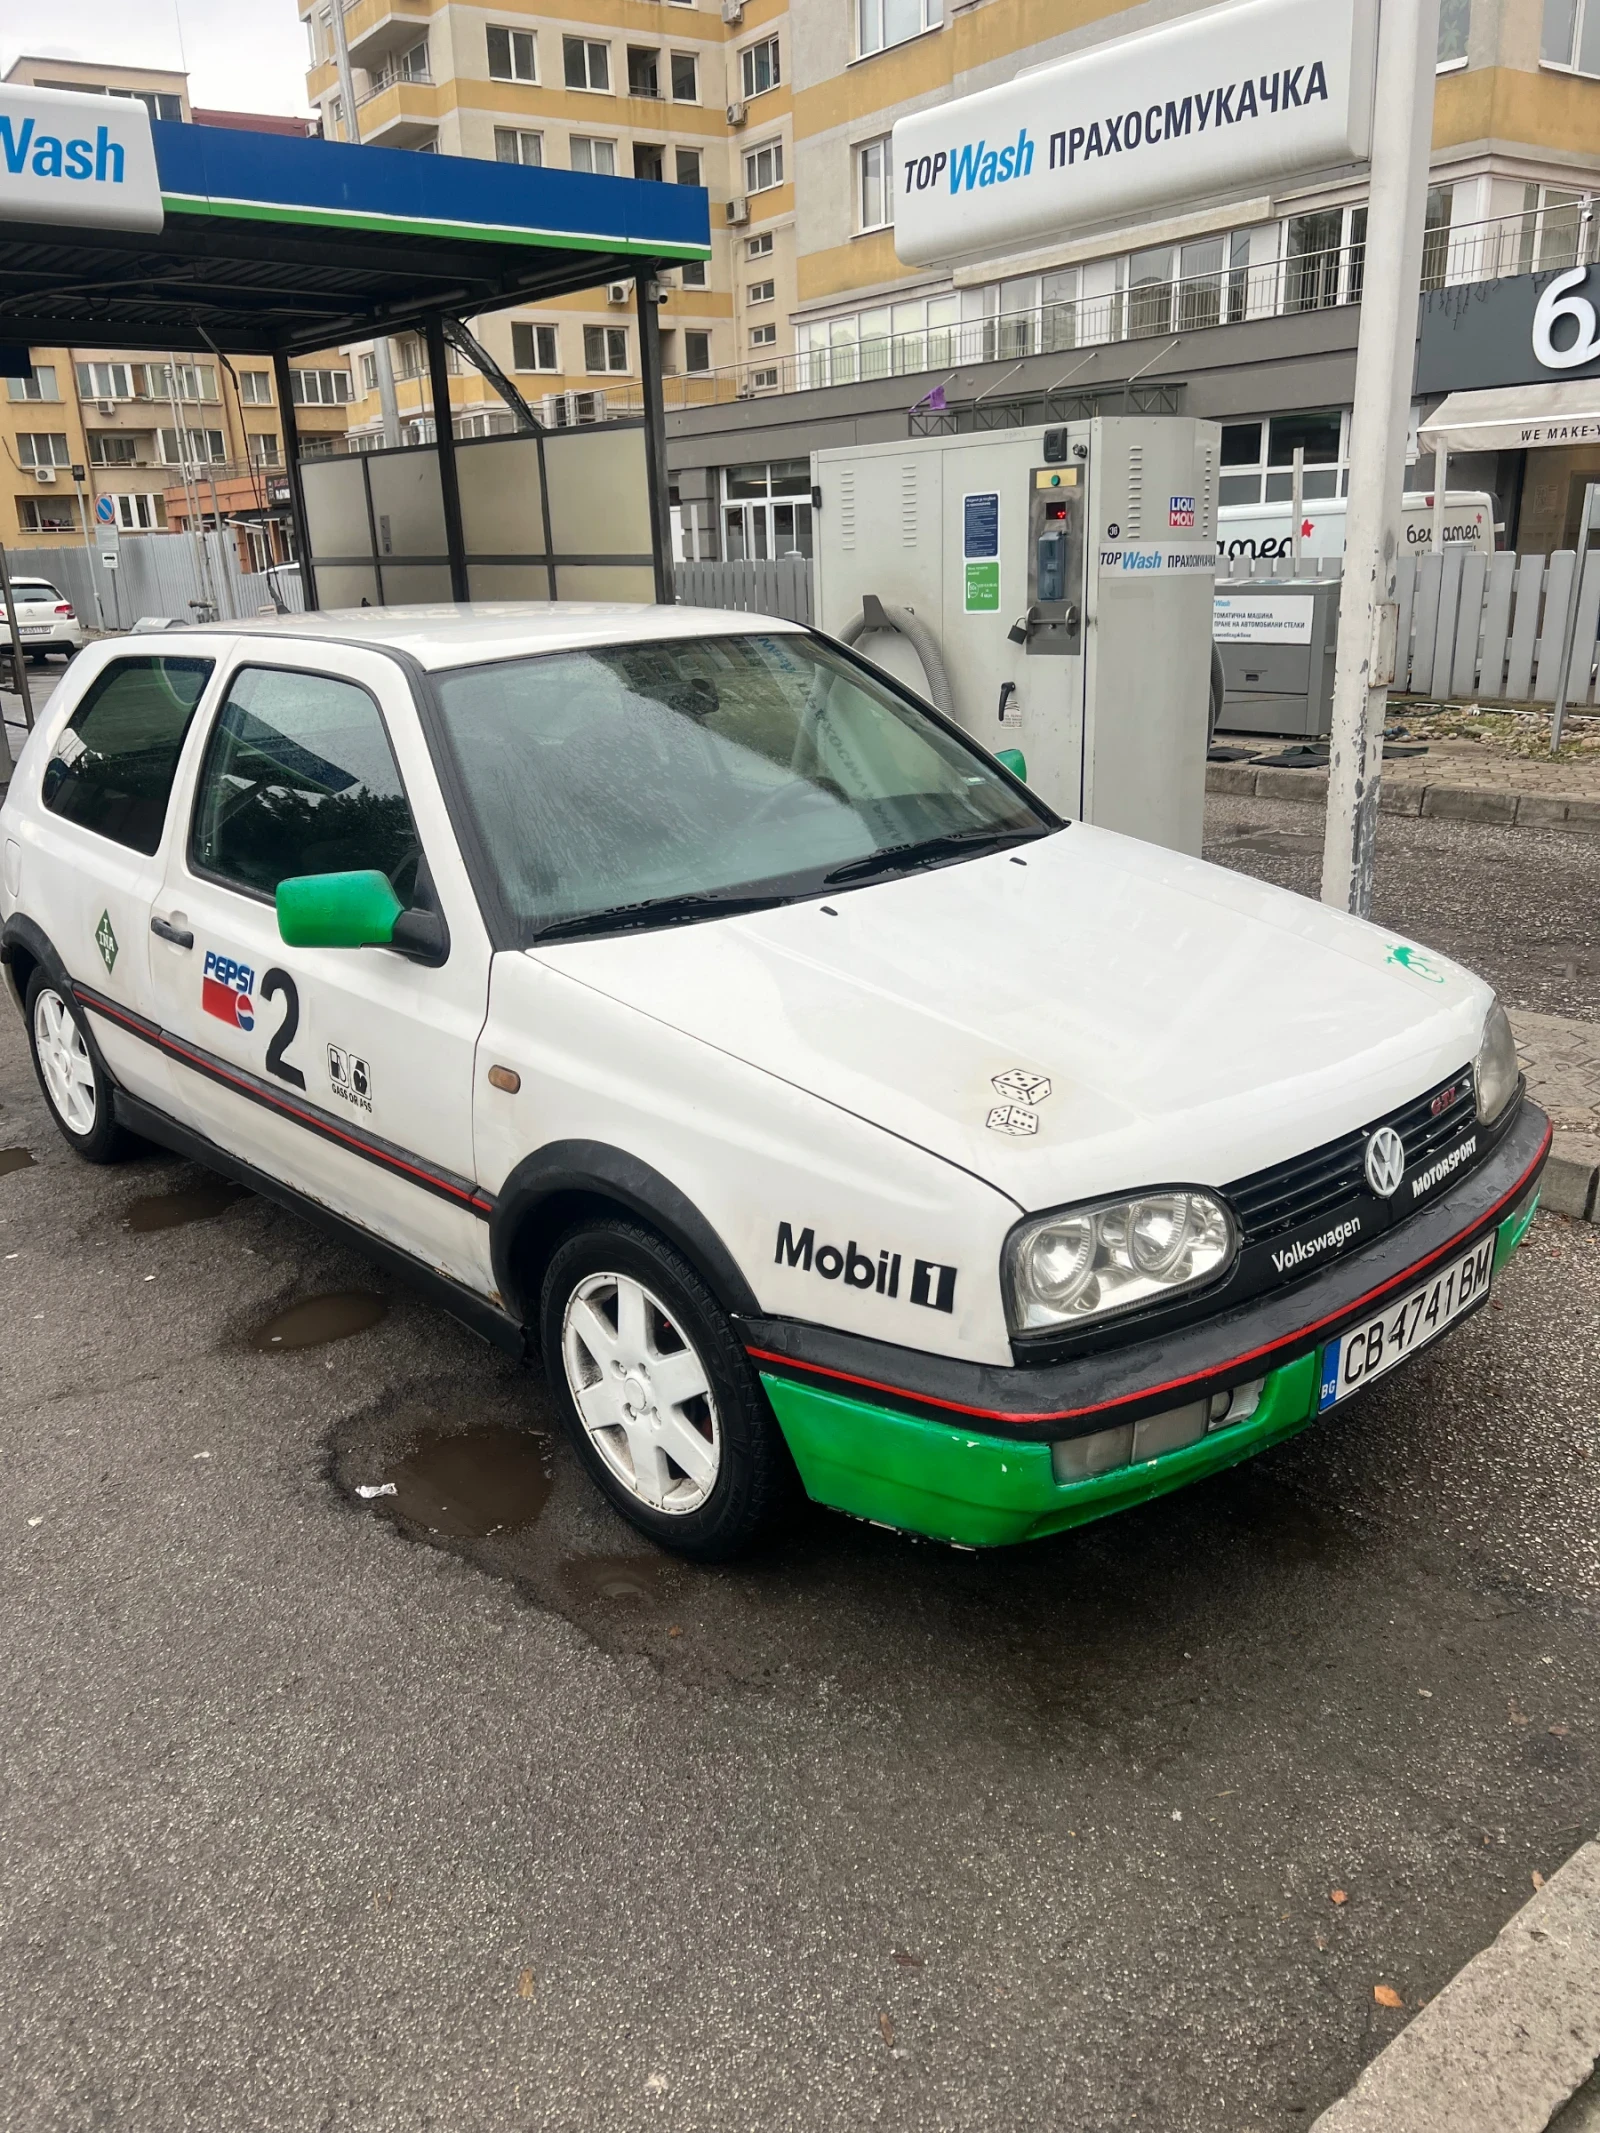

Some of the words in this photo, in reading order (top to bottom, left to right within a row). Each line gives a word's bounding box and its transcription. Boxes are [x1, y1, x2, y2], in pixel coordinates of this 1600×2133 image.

[1049, 61, 1329, 170] ПРАХОСМУКАЧКА
[1521, 430, 1541, 441] WE
[1171, 512, 1195, 526] MOLY
[1406, 524, 1481, 544] беамел
[203, 950, 255, 995] PEPSI
[260, 967, 306, 1091] 2
[349, 1092, 359, 1107] OR
[360, 1098, 373, 1114] ASS
[1431, 1086, 1456, 1116] GTI
[1411, 1135, 1477, 1198] MOTORSPORT
[774, 1221, 902, 1299] Mobil
[1271, 1217, 1361, 1273] Volkswagen
[1321, 1379, 1336, 1399] BG
